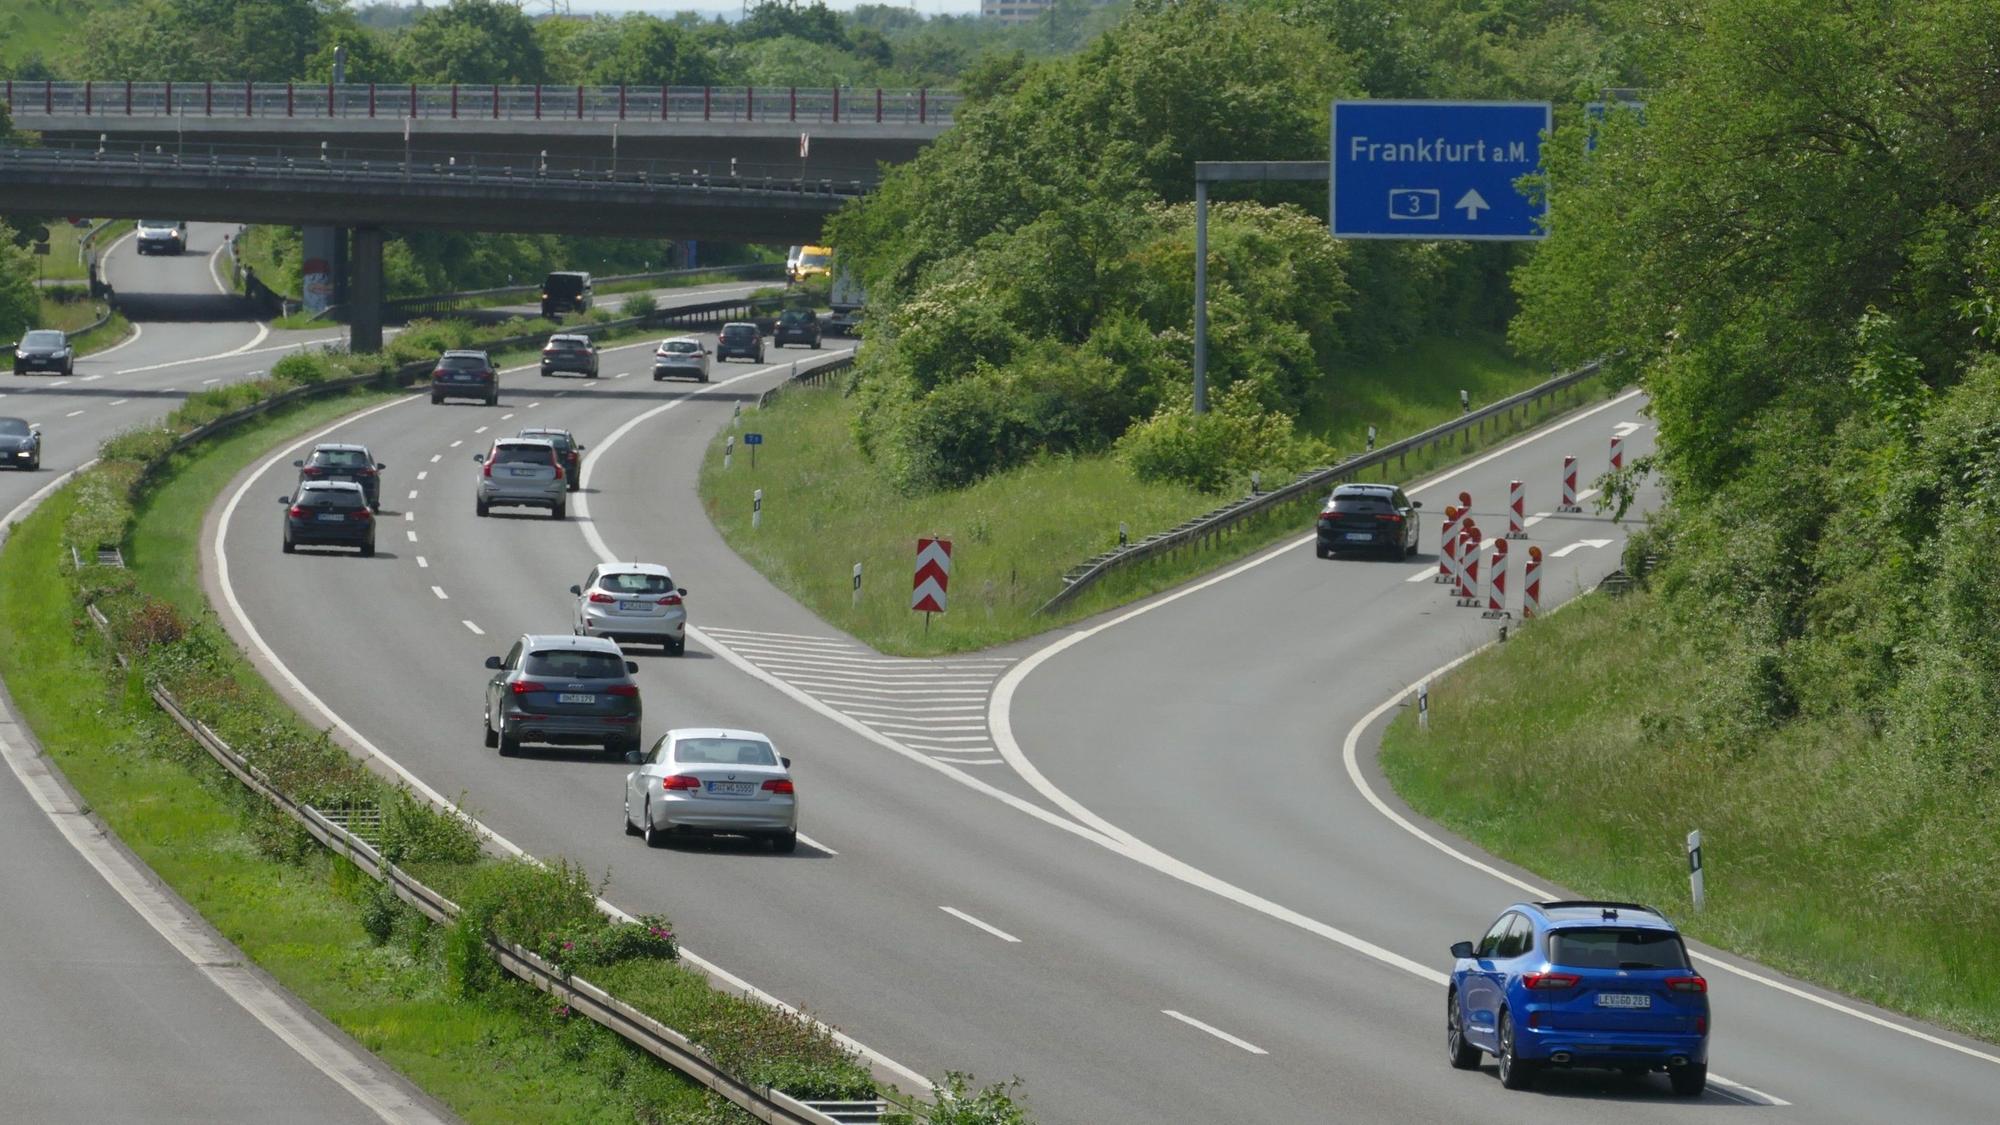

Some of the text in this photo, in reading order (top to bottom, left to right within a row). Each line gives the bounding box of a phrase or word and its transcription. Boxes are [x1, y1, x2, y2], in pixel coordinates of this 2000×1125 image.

[1351, 136, 1530, 163] Frankfurt a.M.
[1408, 195, 1421, 213] 3
